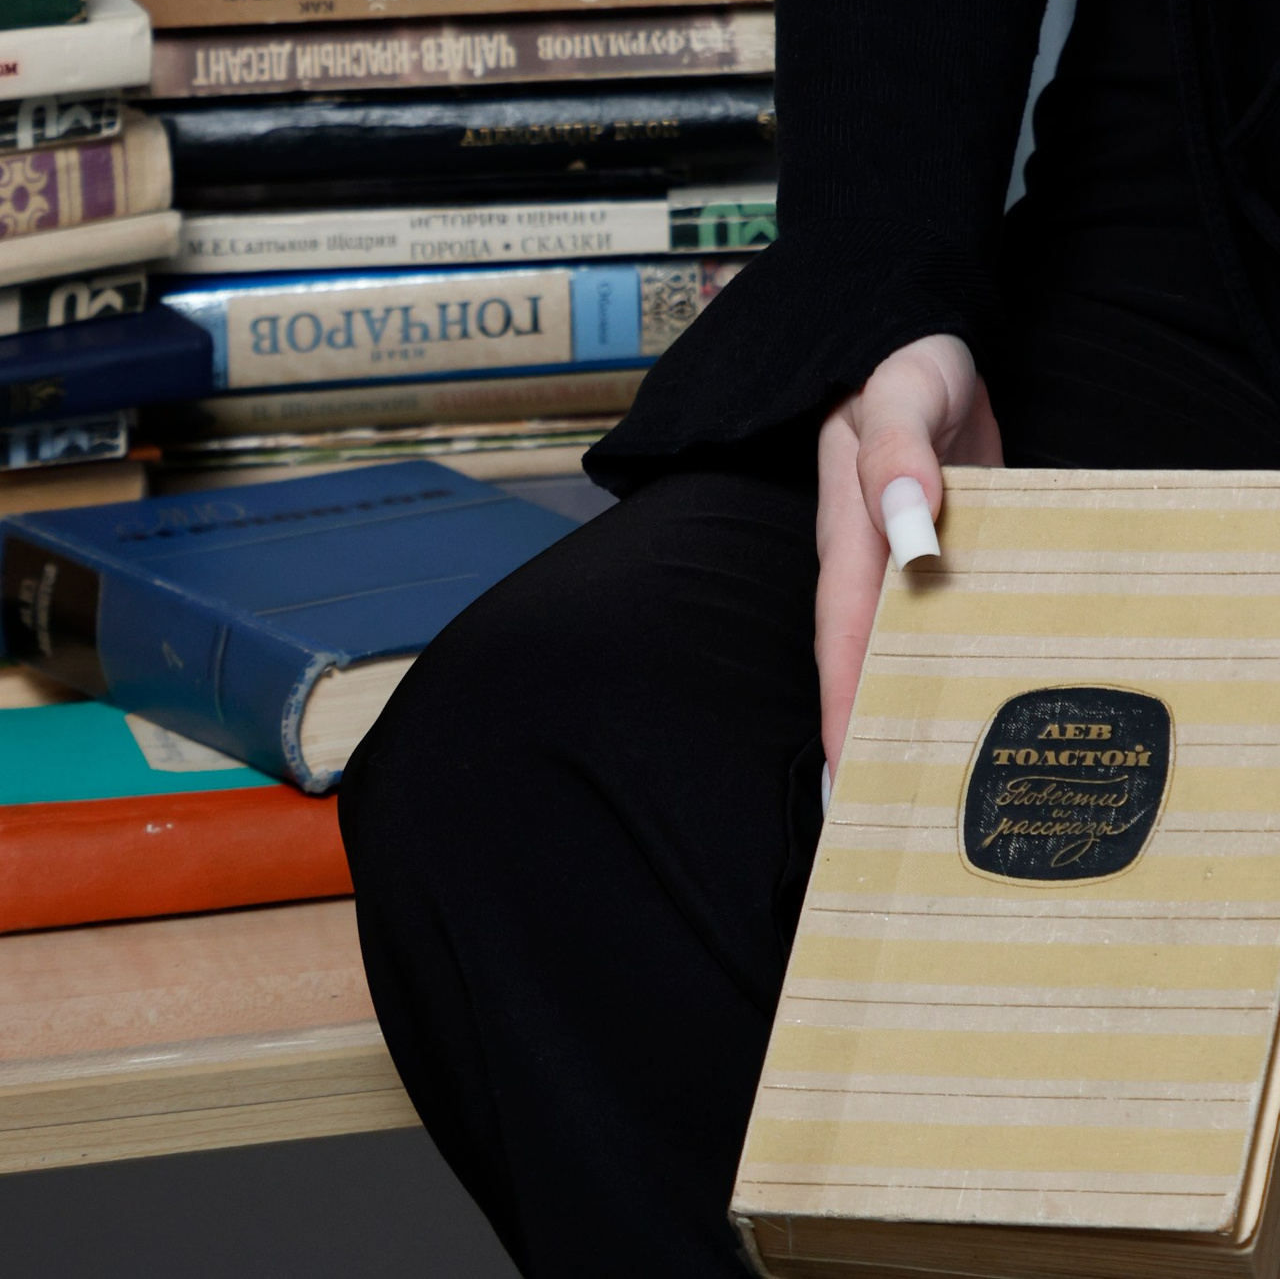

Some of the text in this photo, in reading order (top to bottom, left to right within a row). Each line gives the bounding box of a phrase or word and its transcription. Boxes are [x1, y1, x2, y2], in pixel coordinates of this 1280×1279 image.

[192, 40, 291, 86] ДЕСАНТ
[410, 232, 613, 262] ГОРОДА СКАЗКИ
[250, 296, 543, 355] ГОНЧАРОВ
[1038, 723, 1113, 740] ЛЕВ
[992, 744, 1152, 767] ТОЛСТОЙ
[996, 774, 1128, 807] Повести
[978, 817, 1128, 867] рассказы
